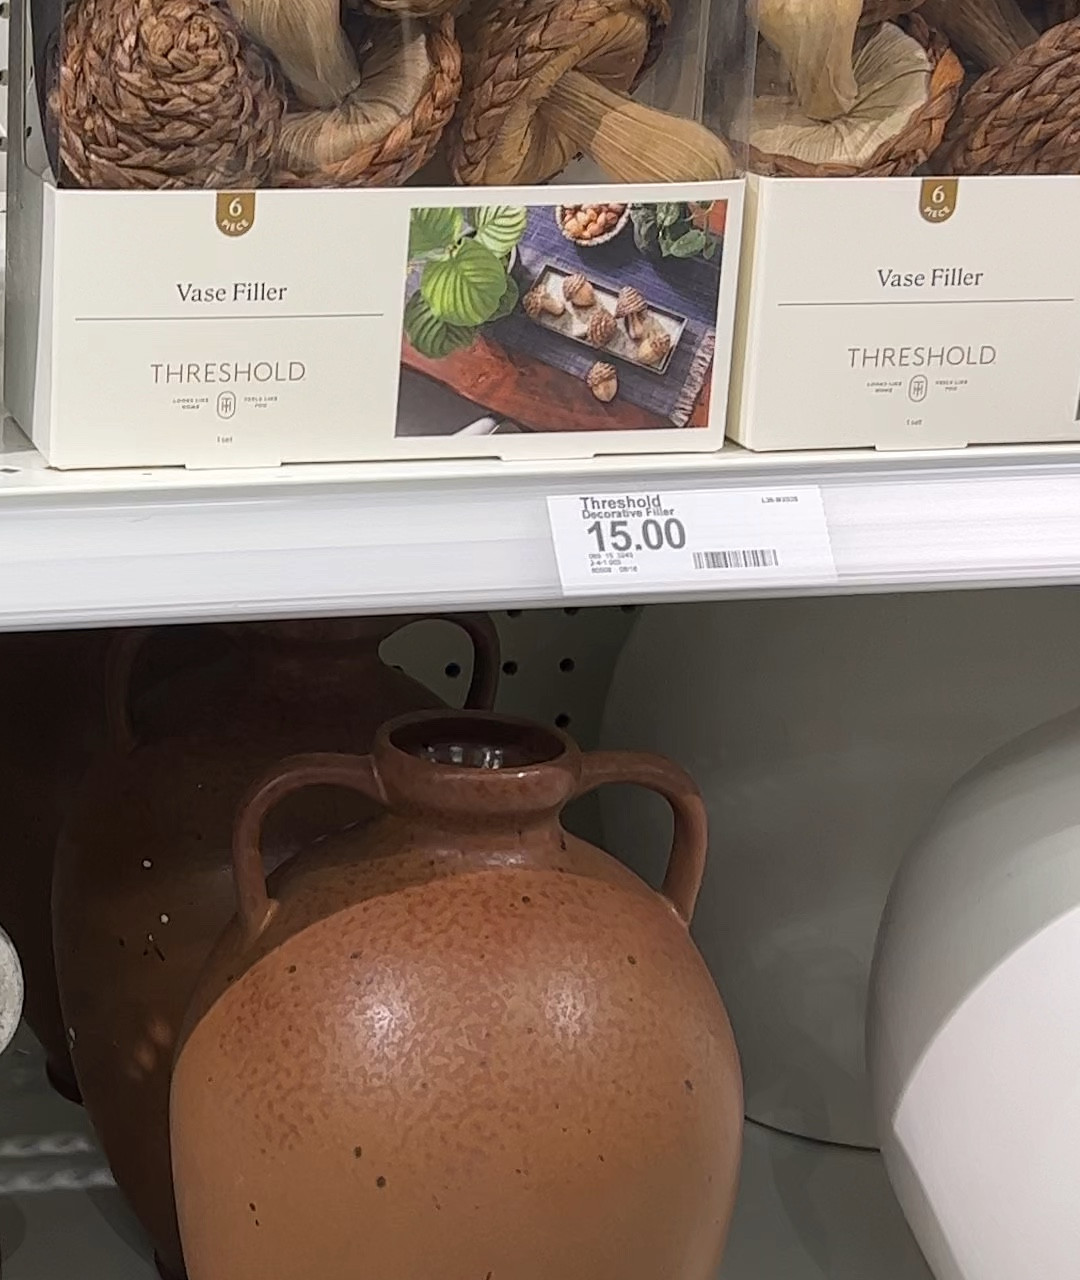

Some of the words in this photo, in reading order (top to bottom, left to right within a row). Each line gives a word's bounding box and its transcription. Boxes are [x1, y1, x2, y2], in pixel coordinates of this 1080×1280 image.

[931, 185, 945, 204] 6
[229, 196, 243, 218] 6
[221, 219, 250, 232] PIECE
[877, 269, 925, 287] Vase
[931, 268, 984, 287] Filler
[176, 283, 227, 303] Vase
[232, 282, 288, 302] Filler
[848, 345, 997, 368] THRESHOLD
[150, 361, 306, 384] THRESHOLD
[580, 494, 661, 510] Threshold
[582, 509, 643, 520] Decorative
[646, 507, 674, 517] Filler
[587, 518, 686, 552] 15.00
